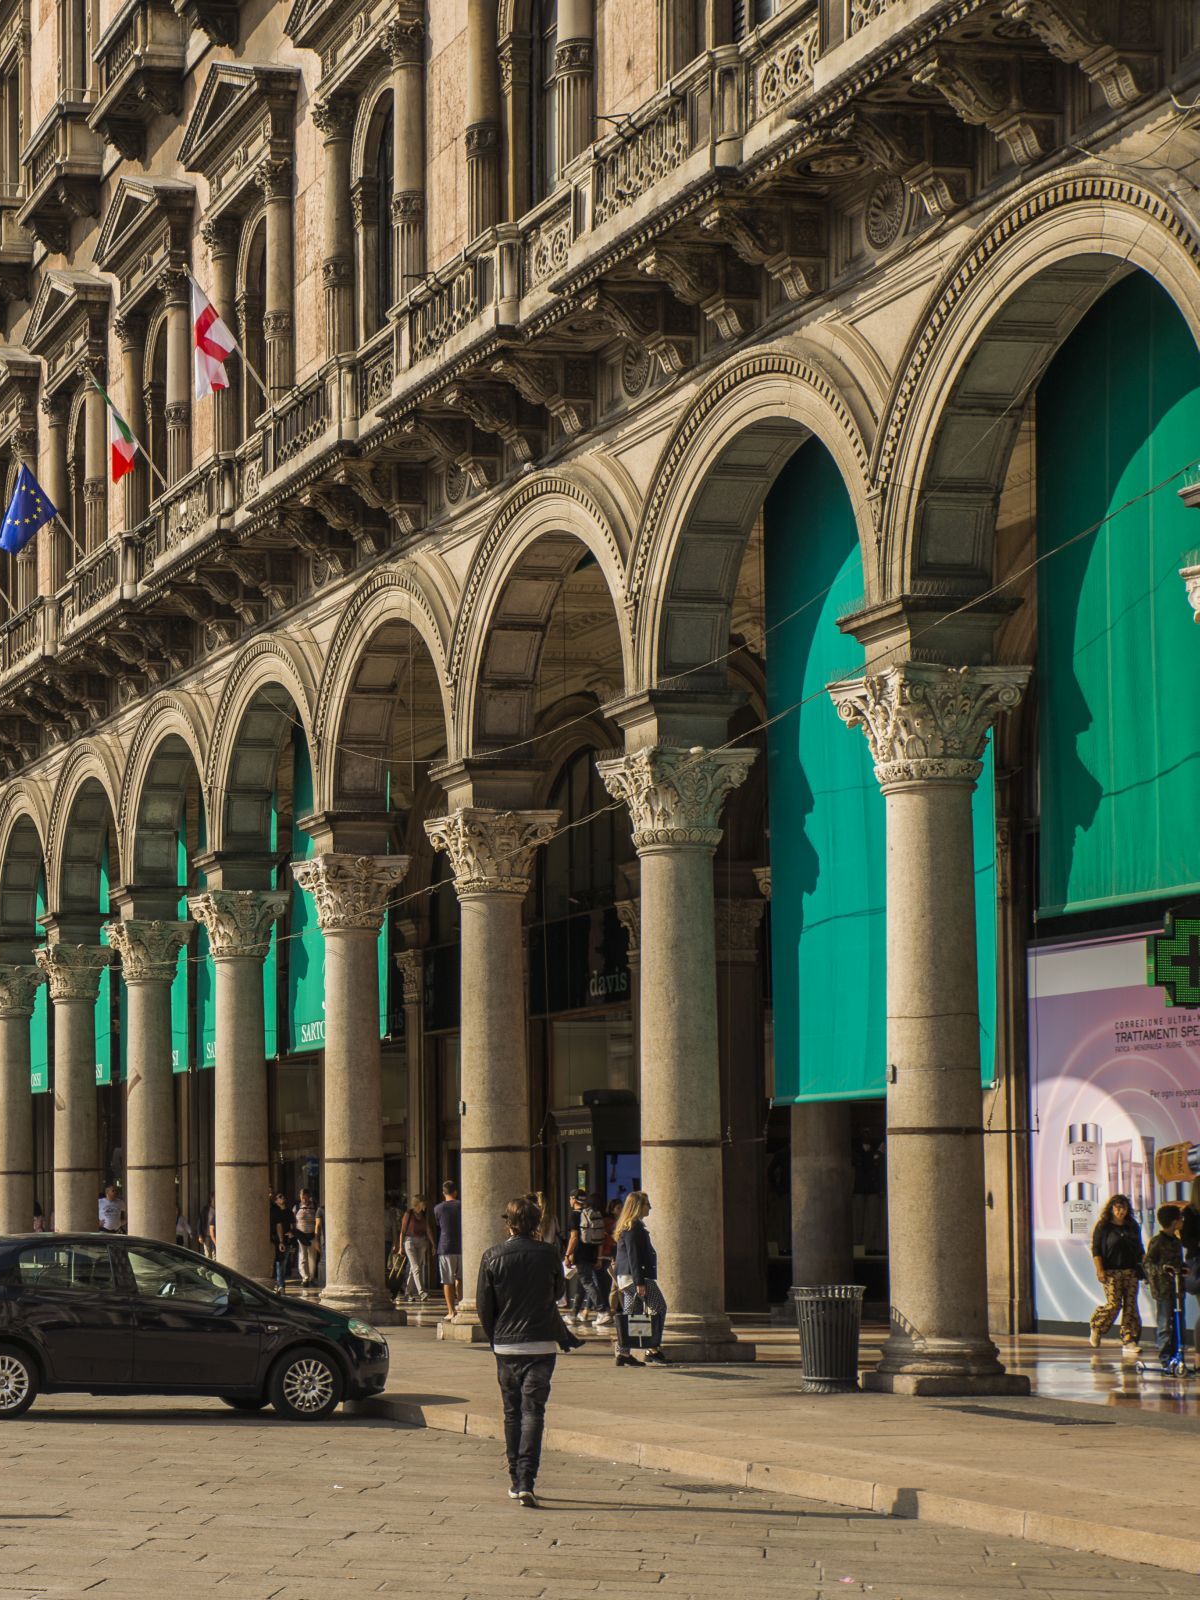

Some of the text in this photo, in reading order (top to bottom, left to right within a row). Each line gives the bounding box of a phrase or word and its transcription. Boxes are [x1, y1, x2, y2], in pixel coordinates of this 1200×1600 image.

[590, 966, 627, 996] davis
[1115, 1017, 1163, 1030] CORREZIONE
[1115, 1027, 1178, 1043] TRATTAMENTI
[1072, 1145, 1094, 1155] LIERAC
[1069, 1203, 1092, 1213] LIERAC
